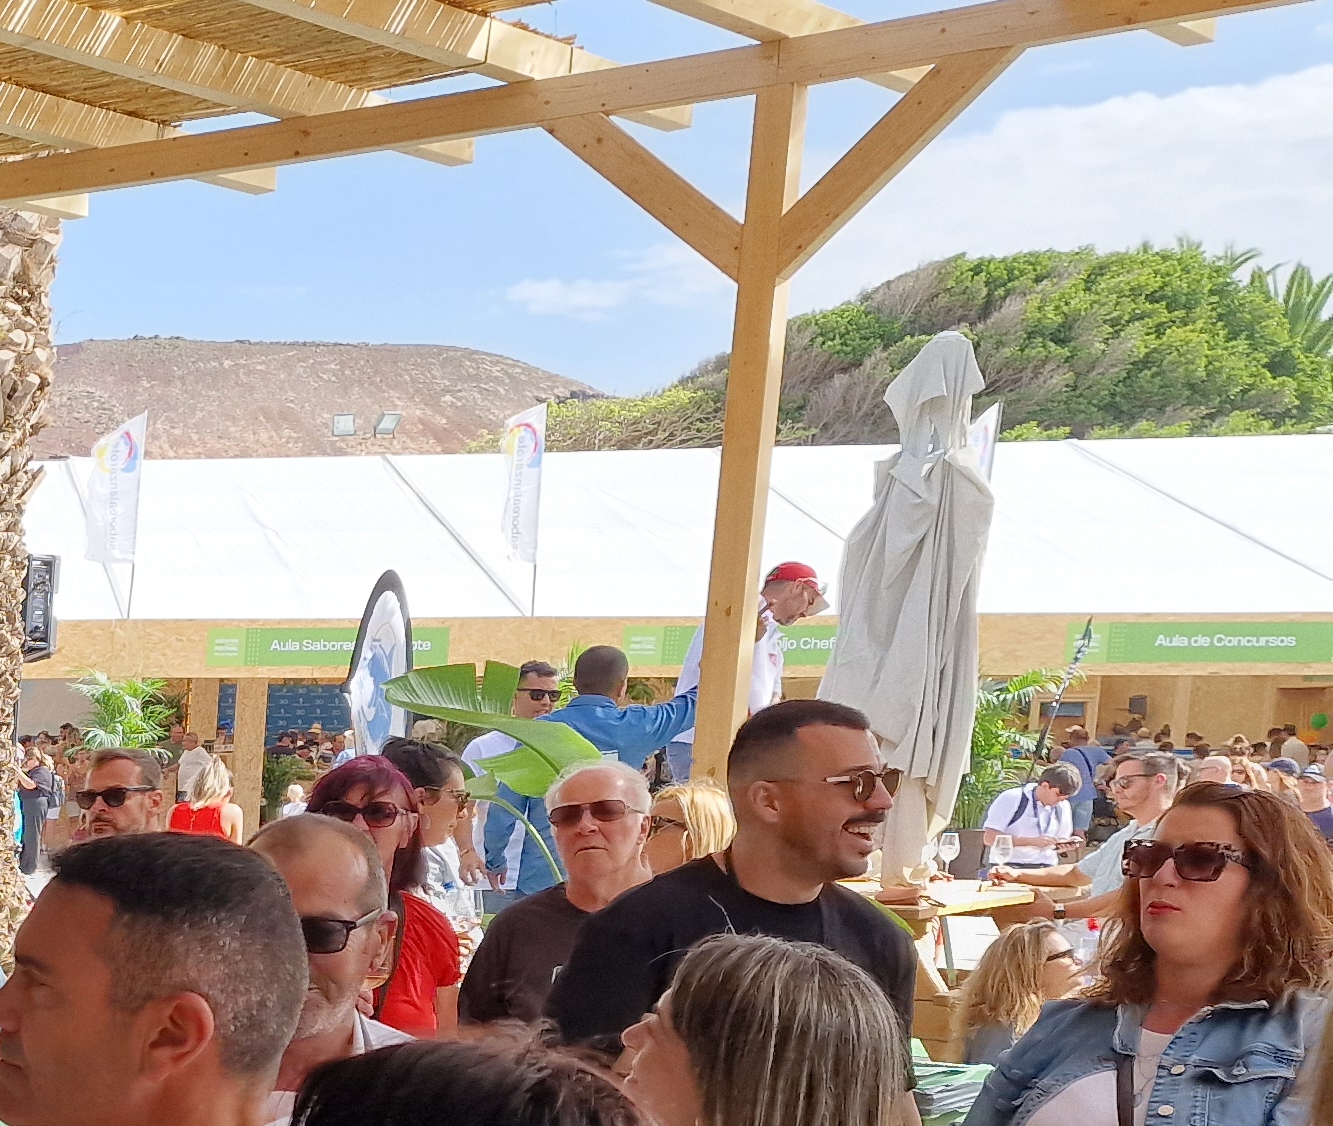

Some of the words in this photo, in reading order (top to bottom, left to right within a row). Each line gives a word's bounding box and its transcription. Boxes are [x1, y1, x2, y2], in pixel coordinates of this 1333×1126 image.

[270, 639, 300, 651] Aula
[1155, 634, 1188, 647] Aula
[1191, 634, 1211, 647] de
[1214, 634, 1296, 647] Concursos
